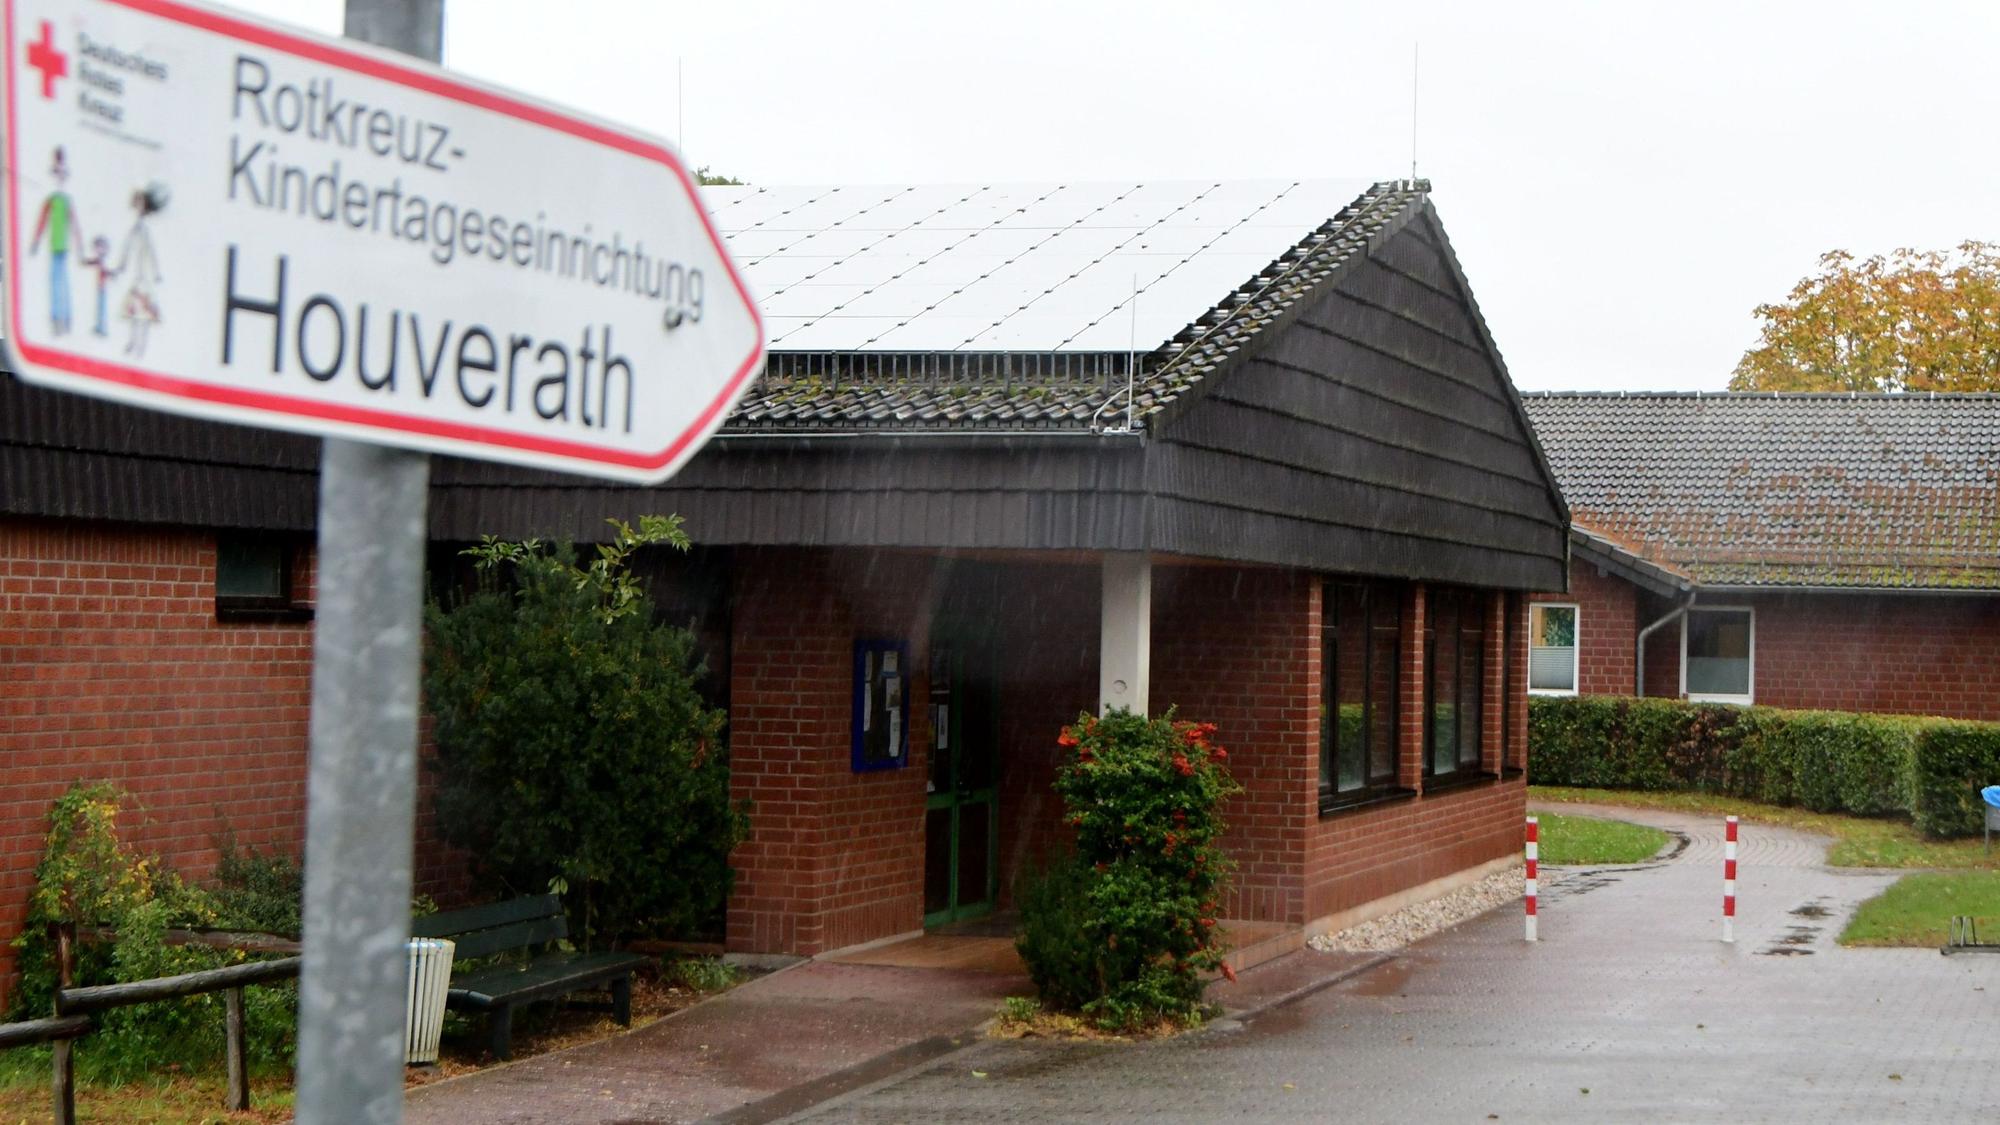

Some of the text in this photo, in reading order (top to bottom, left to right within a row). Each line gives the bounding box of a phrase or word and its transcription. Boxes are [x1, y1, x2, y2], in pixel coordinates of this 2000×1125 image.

[232, 54, 467, 171] Rotkreuz-
[227, 134, 705, 322] Kindertageseinrichtung
[220, 244, 636, 433] Houverath
